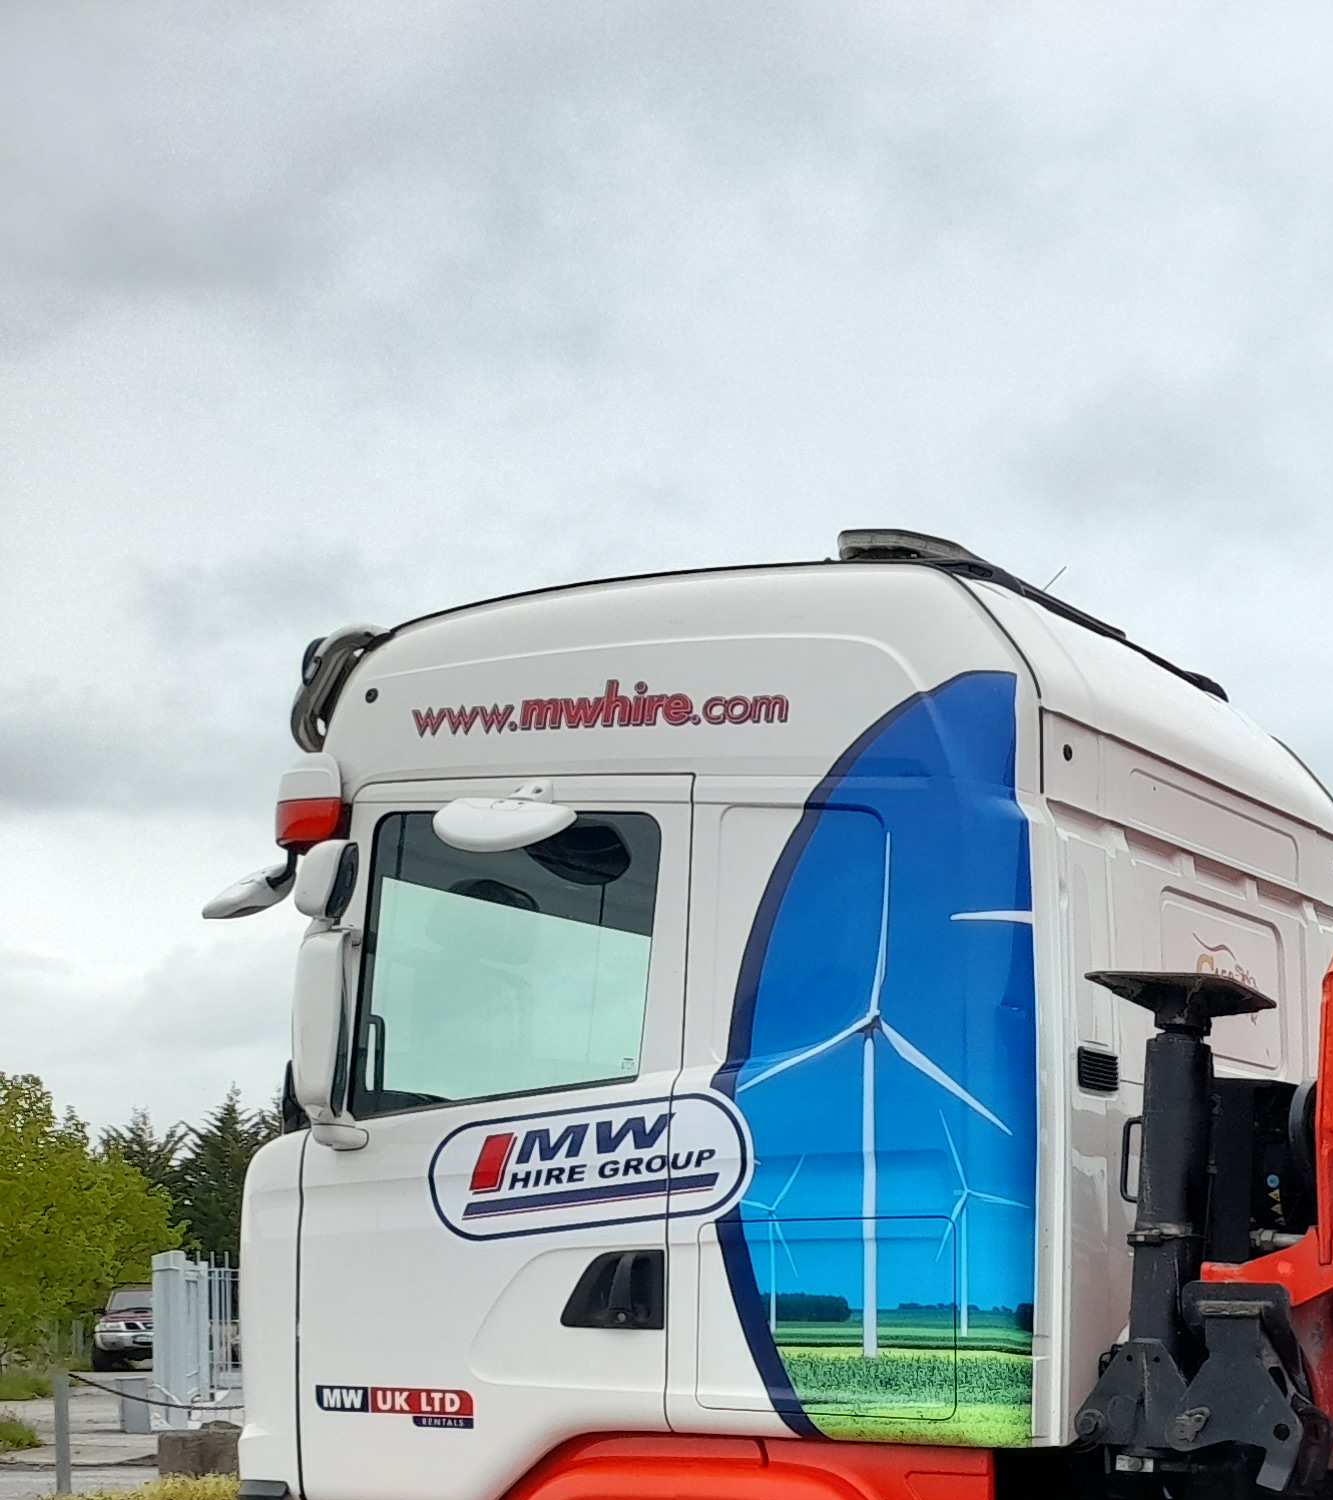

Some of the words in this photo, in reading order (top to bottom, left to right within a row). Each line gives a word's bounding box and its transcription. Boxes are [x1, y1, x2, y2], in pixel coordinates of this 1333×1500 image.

[411, 679, 790, 739] www.mwhire.com
[515, 1112, 677, 1165] MW
[508, 1164, 588, 1191] HIRE
[597, 1148, 717, 1179] GROUP
[322, 1388, 364, 1409] MW
[376, 1390, 411, 1412] UK
[420, 1392, 462, 1413] LTD
[421, 1417, 465, 1428] RENTALS
